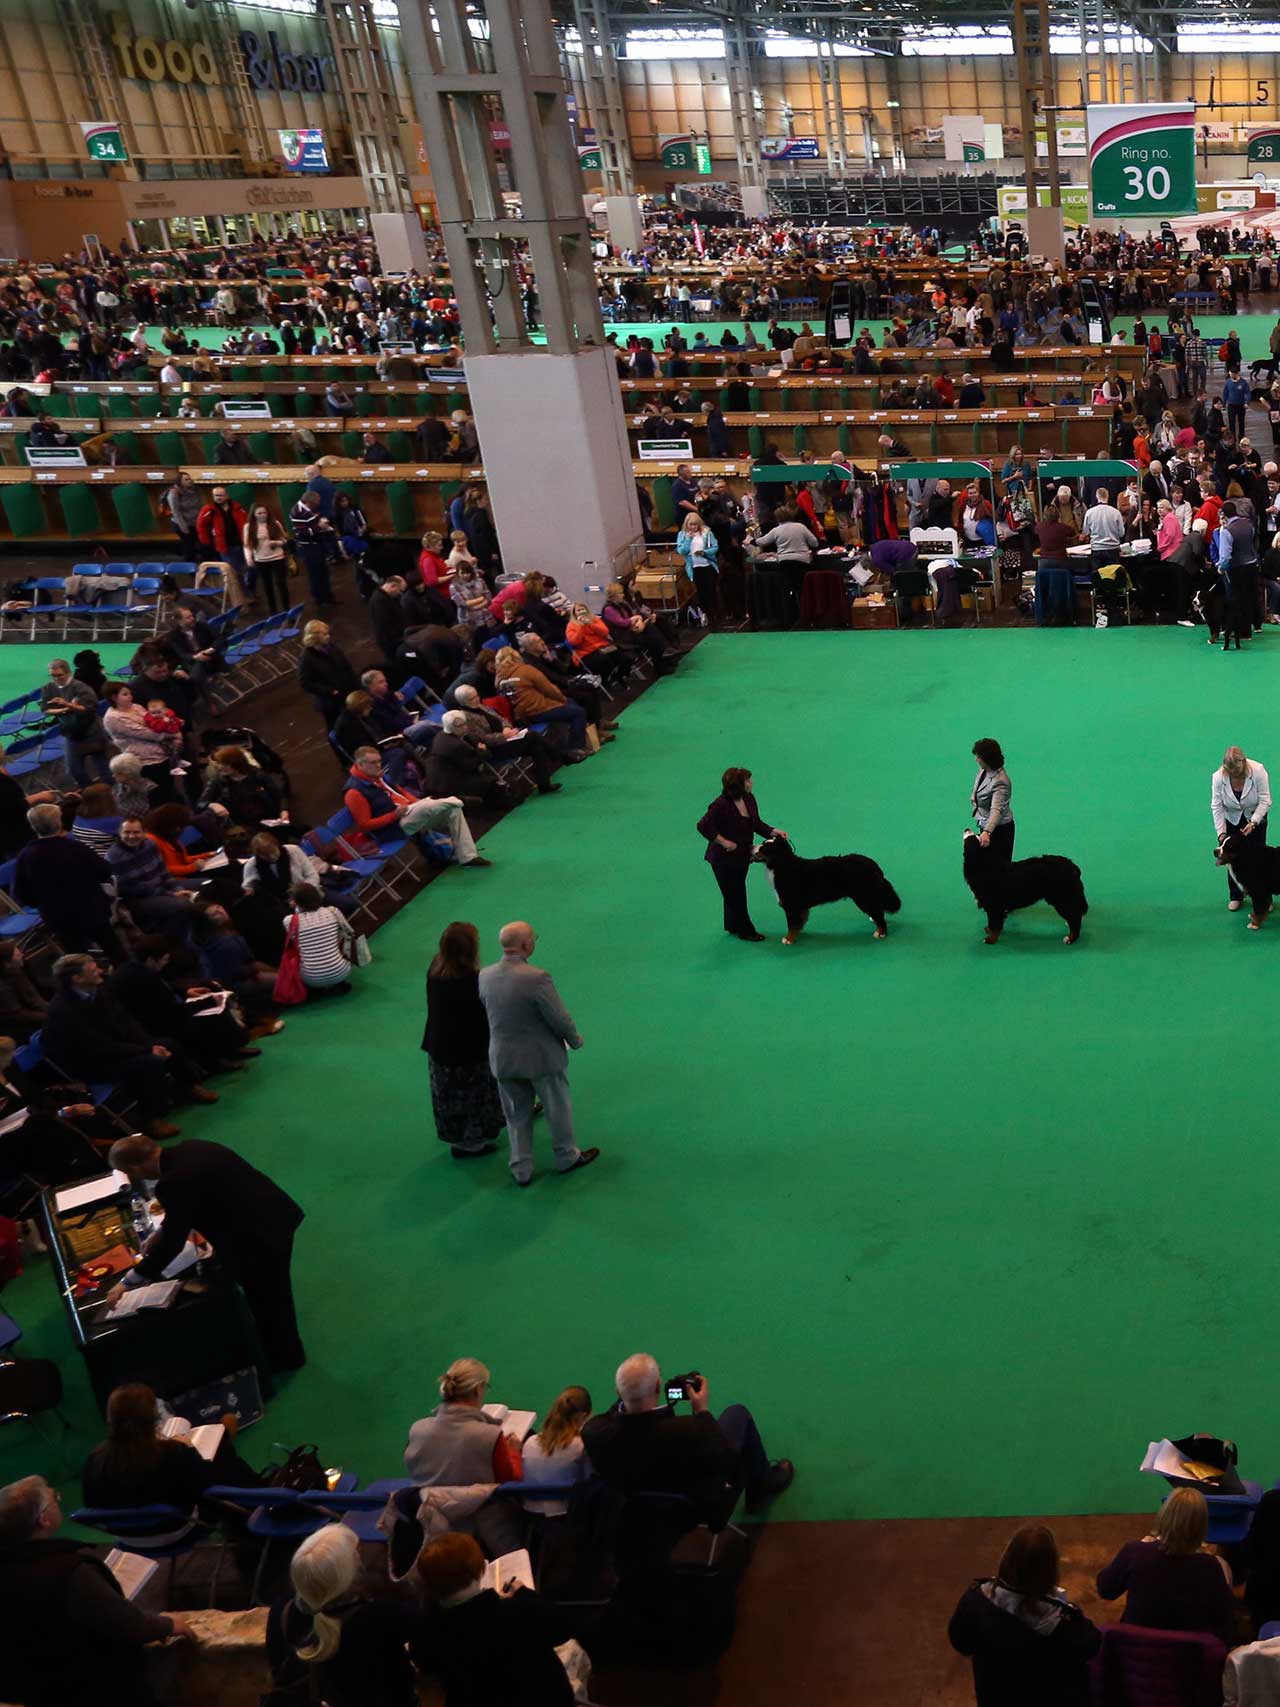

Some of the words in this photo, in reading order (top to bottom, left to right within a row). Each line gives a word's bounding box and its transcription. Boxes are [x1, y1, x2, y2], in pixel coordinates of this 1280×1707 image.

[112, 13, 221, 86] food
[1256, 81, 1268, 102] 5
[97, 143, 115, 156] 34
[1121, 147, 1149, 162] Ring
[1152, 149, 1172, 159] no.
[1257, 146, 1273, 158] 28
[586, 158, 598, 168] 36
[670, 153, 686, 165] 33
[967, 152, 979, 161] 35
[1123, 165, 1171, 201] 30
